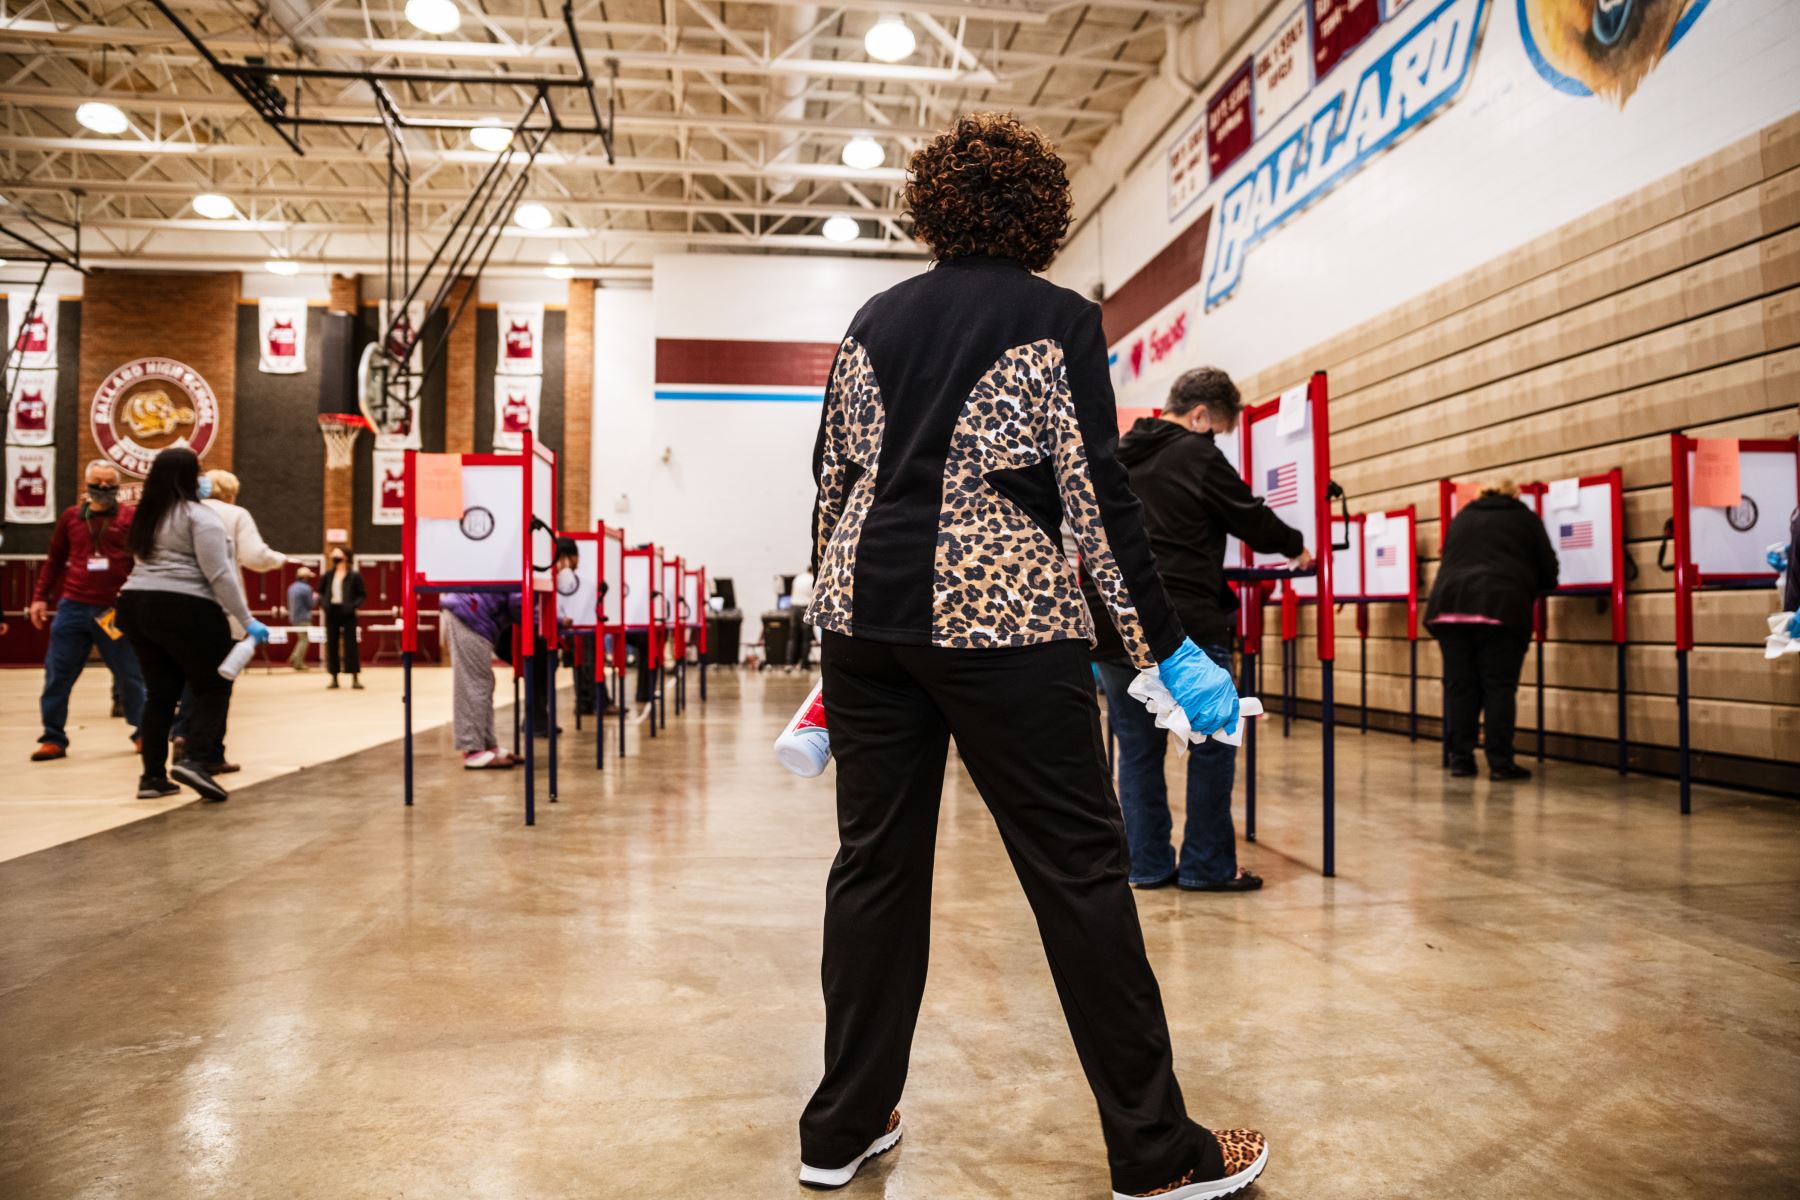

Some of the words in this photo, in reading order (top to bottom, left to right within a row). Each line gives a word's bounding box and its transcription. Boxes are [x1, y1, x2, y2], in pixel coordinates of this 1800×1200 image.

[1206, 0, 1483, 304] BALLARD
[95, 364, 144, 424] BALLARD
[146, 362, 184, 380] HIGH
[183, 372, 213, 427] SCHOOL
[107, 443, 153, 475] BRU
